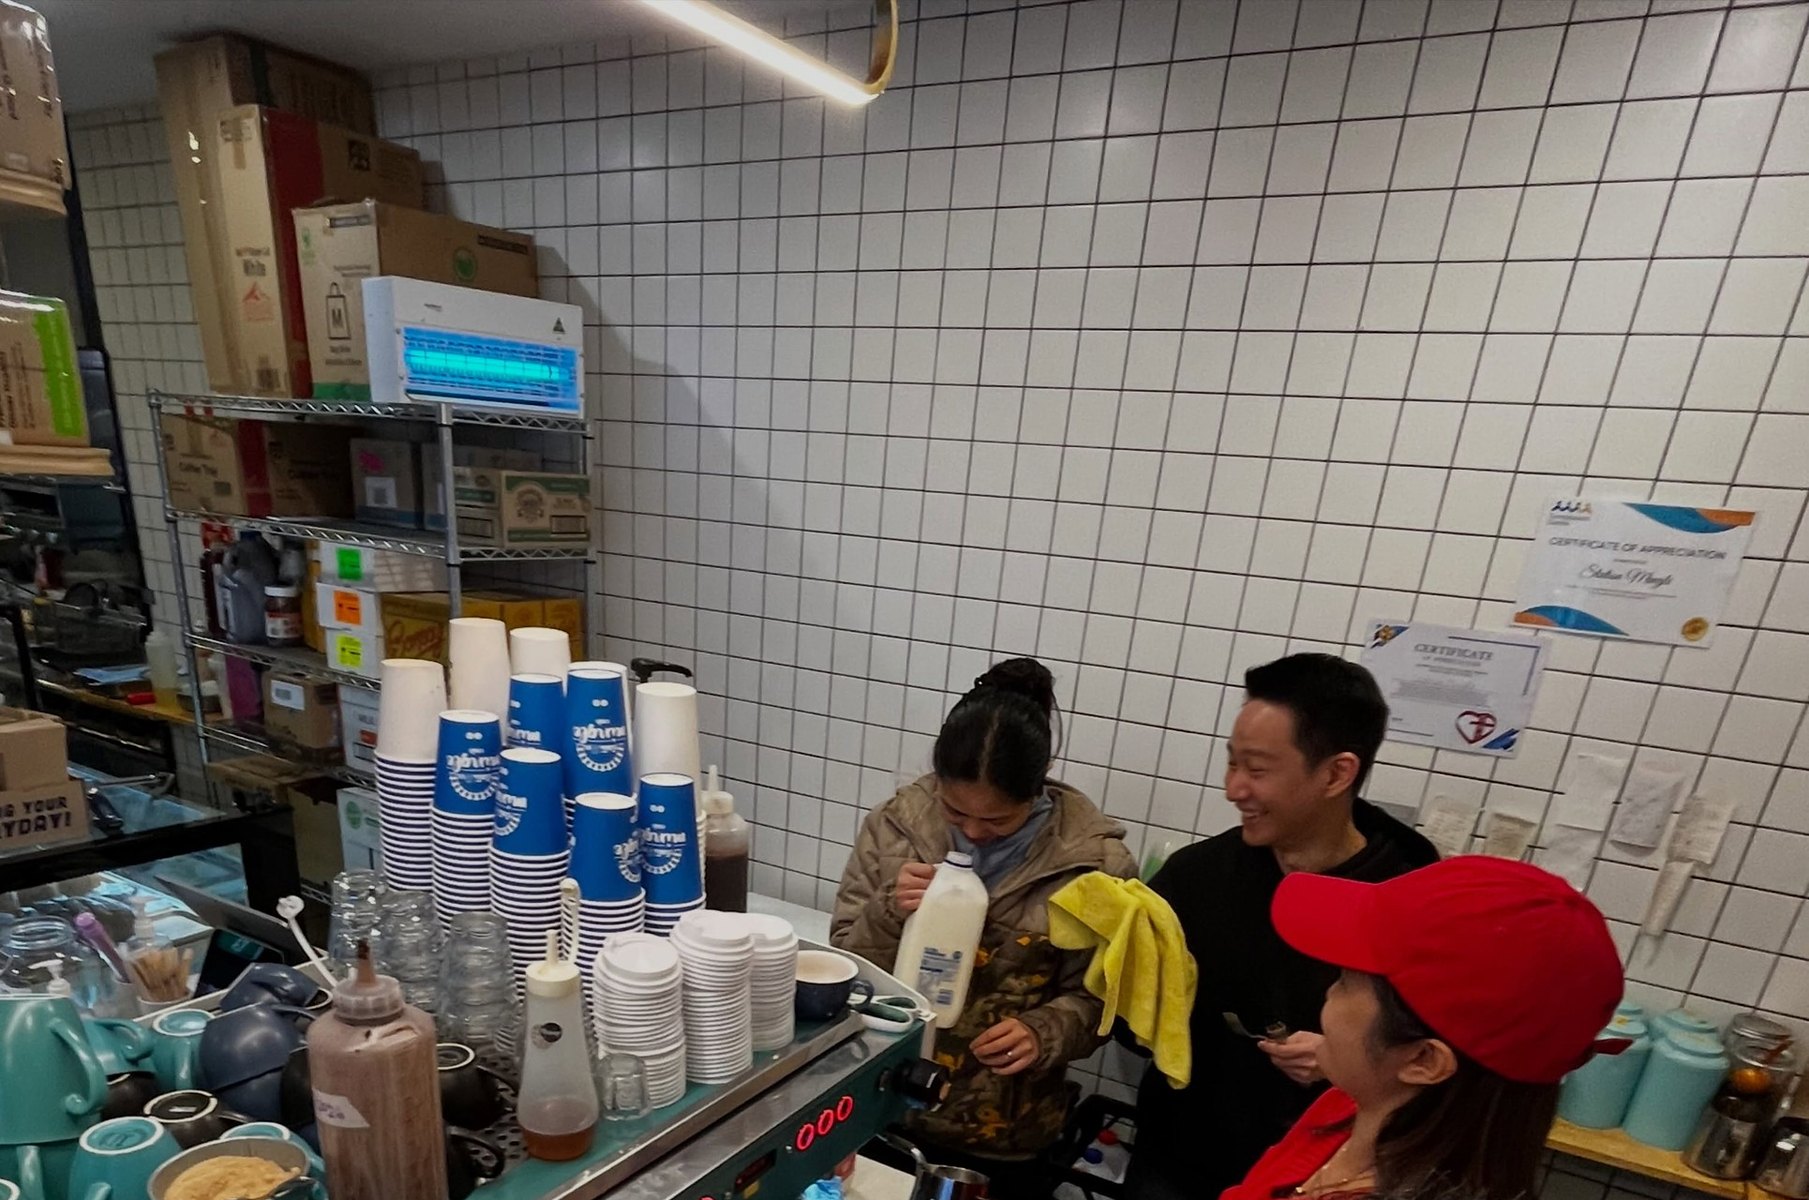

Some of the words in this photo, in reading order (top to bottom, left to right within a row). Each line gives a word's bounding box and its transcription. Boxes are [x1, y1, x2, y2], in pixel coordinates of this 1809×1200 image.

[1549, 536, 1619, 552] CERTIFICATE
[1621, 543, 1639, 552] OF
[1640, 545, 1728, 561] APPRECIATION
[1413, 643, 1493, 661] CERTIFICATE
[22, 796, 68, 814] YOUR
[0, 811, 72, 839] YDAY!
